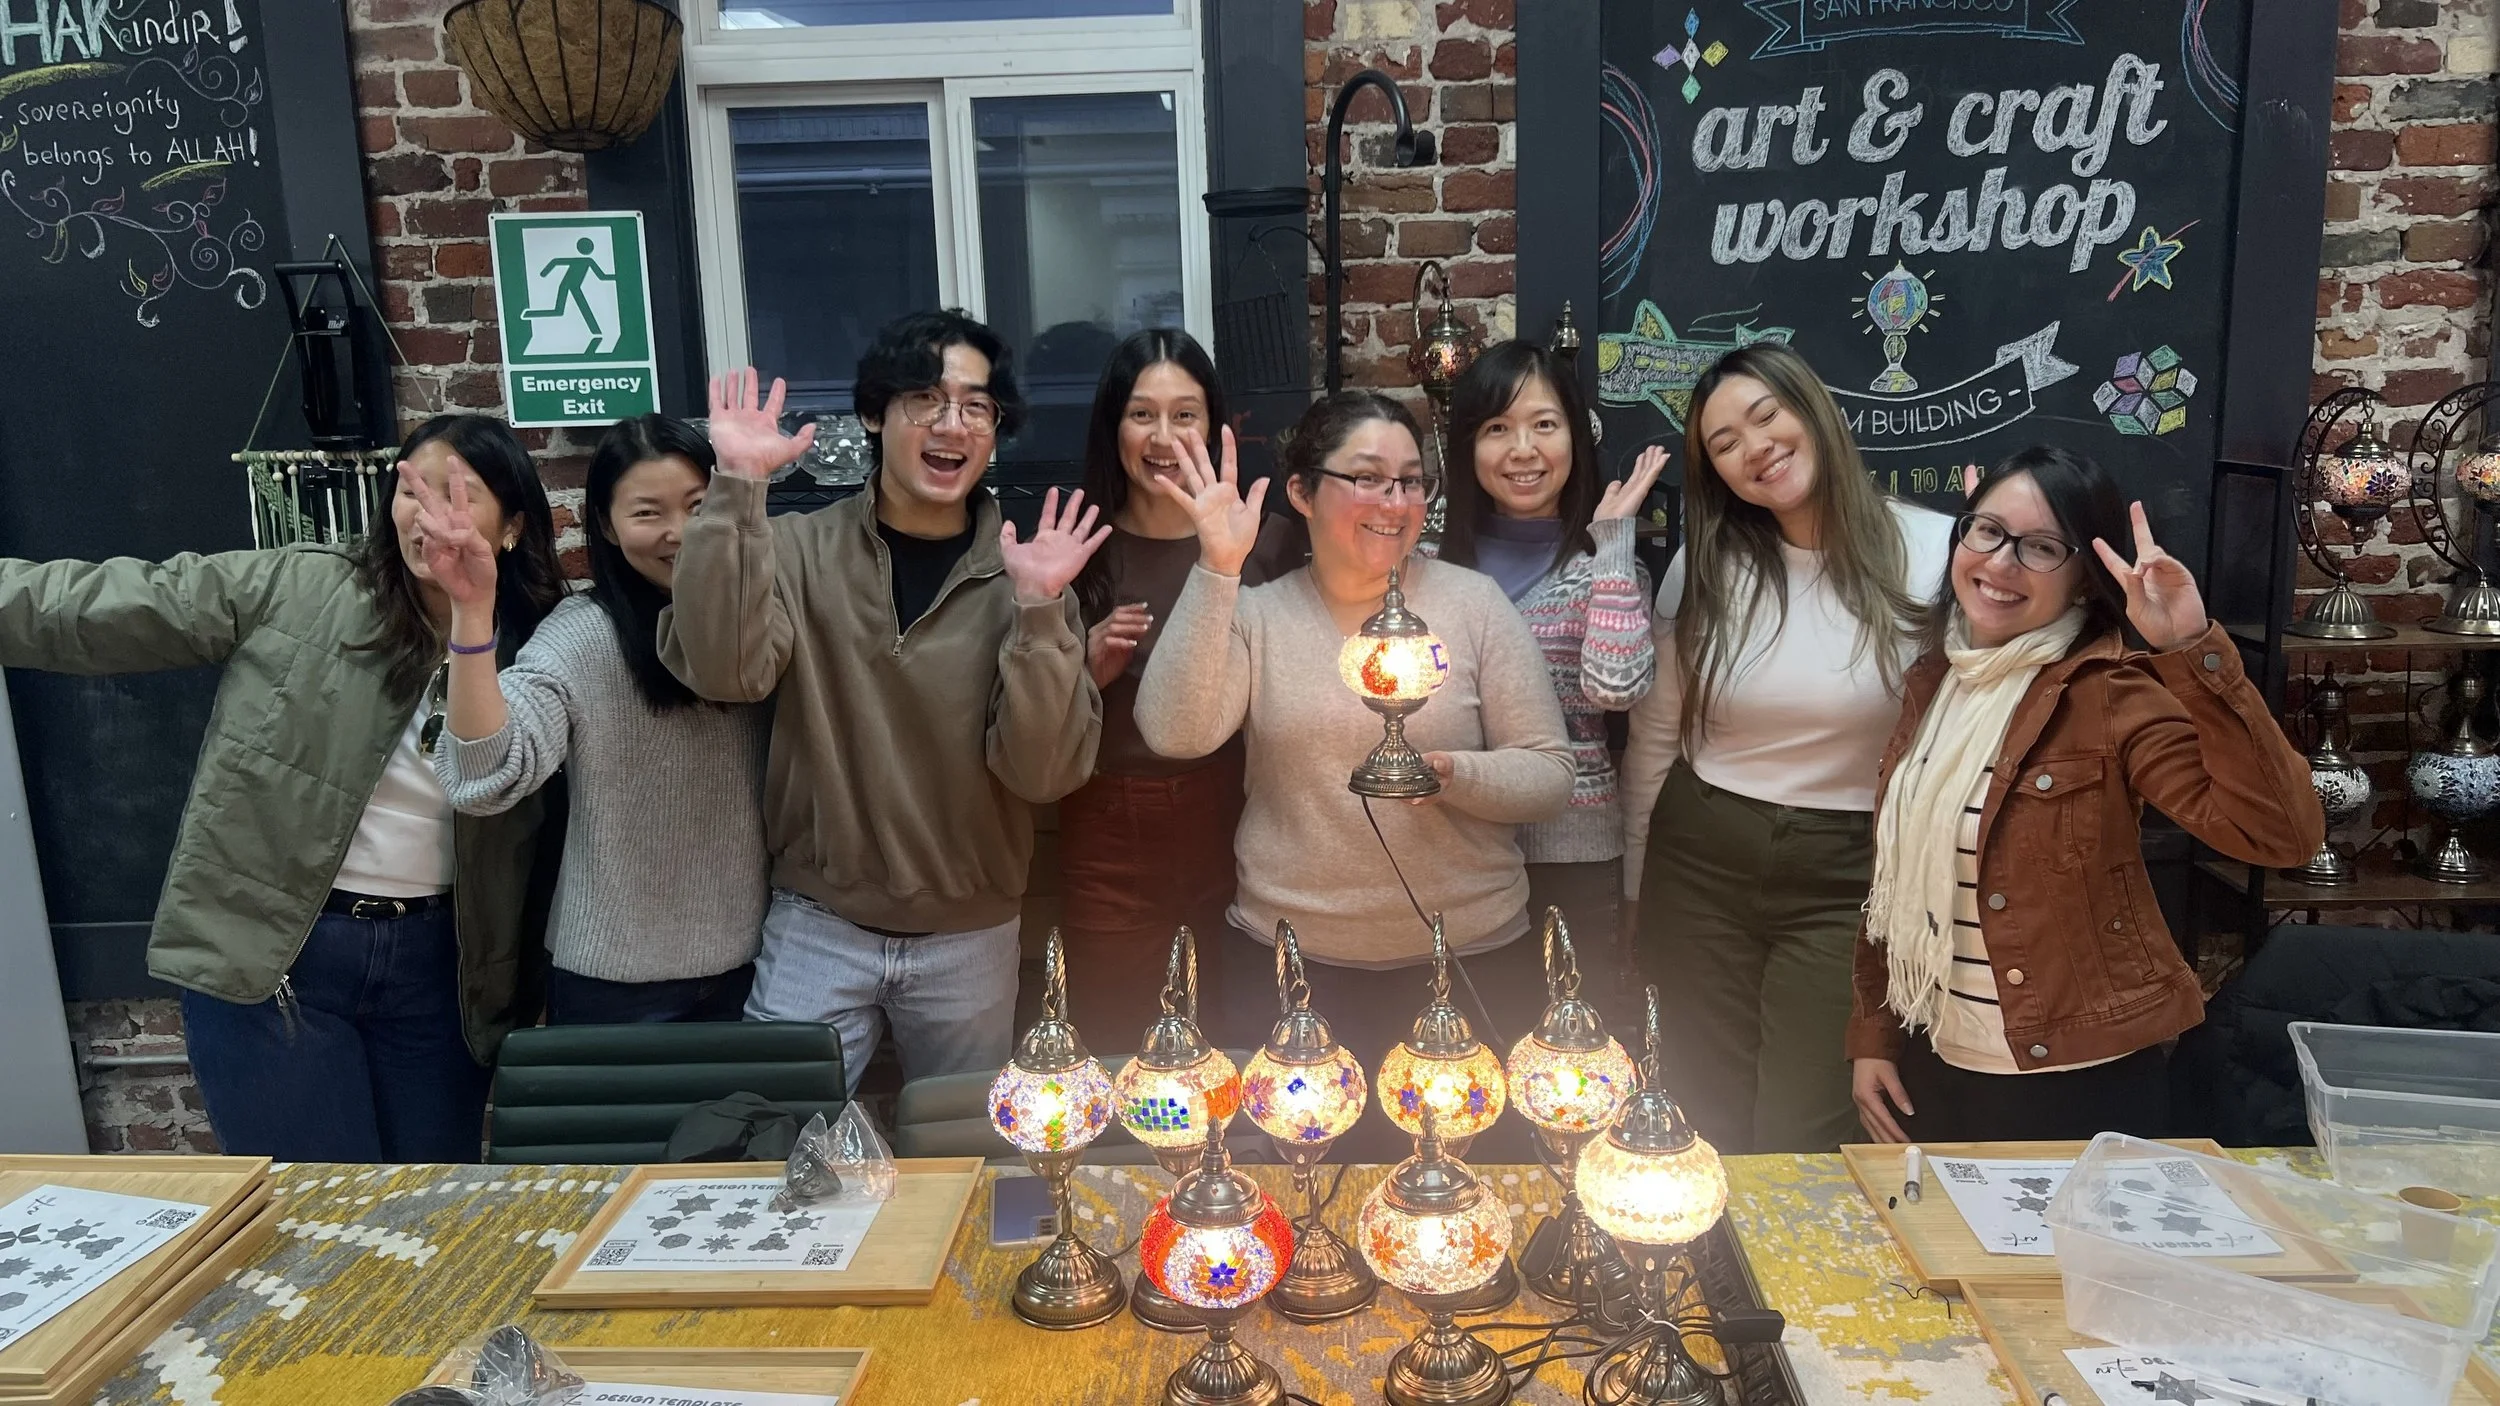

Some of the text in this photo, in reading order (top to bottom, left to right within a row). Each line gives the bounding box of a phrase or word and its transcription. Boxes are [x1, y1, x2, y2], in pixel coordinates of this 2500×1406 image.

[1691, 52, 2168, 177] art & craft
[128, 142, 152, 166] to
[1710, 165, 2137, 274] workshop
[521, 375, 642, 394] Emergency
[563, 398, 606, 415] Exit
[698, 1183, 749, 1192] DESIGN
[595, 1393, 656, 1405] DESIGN
